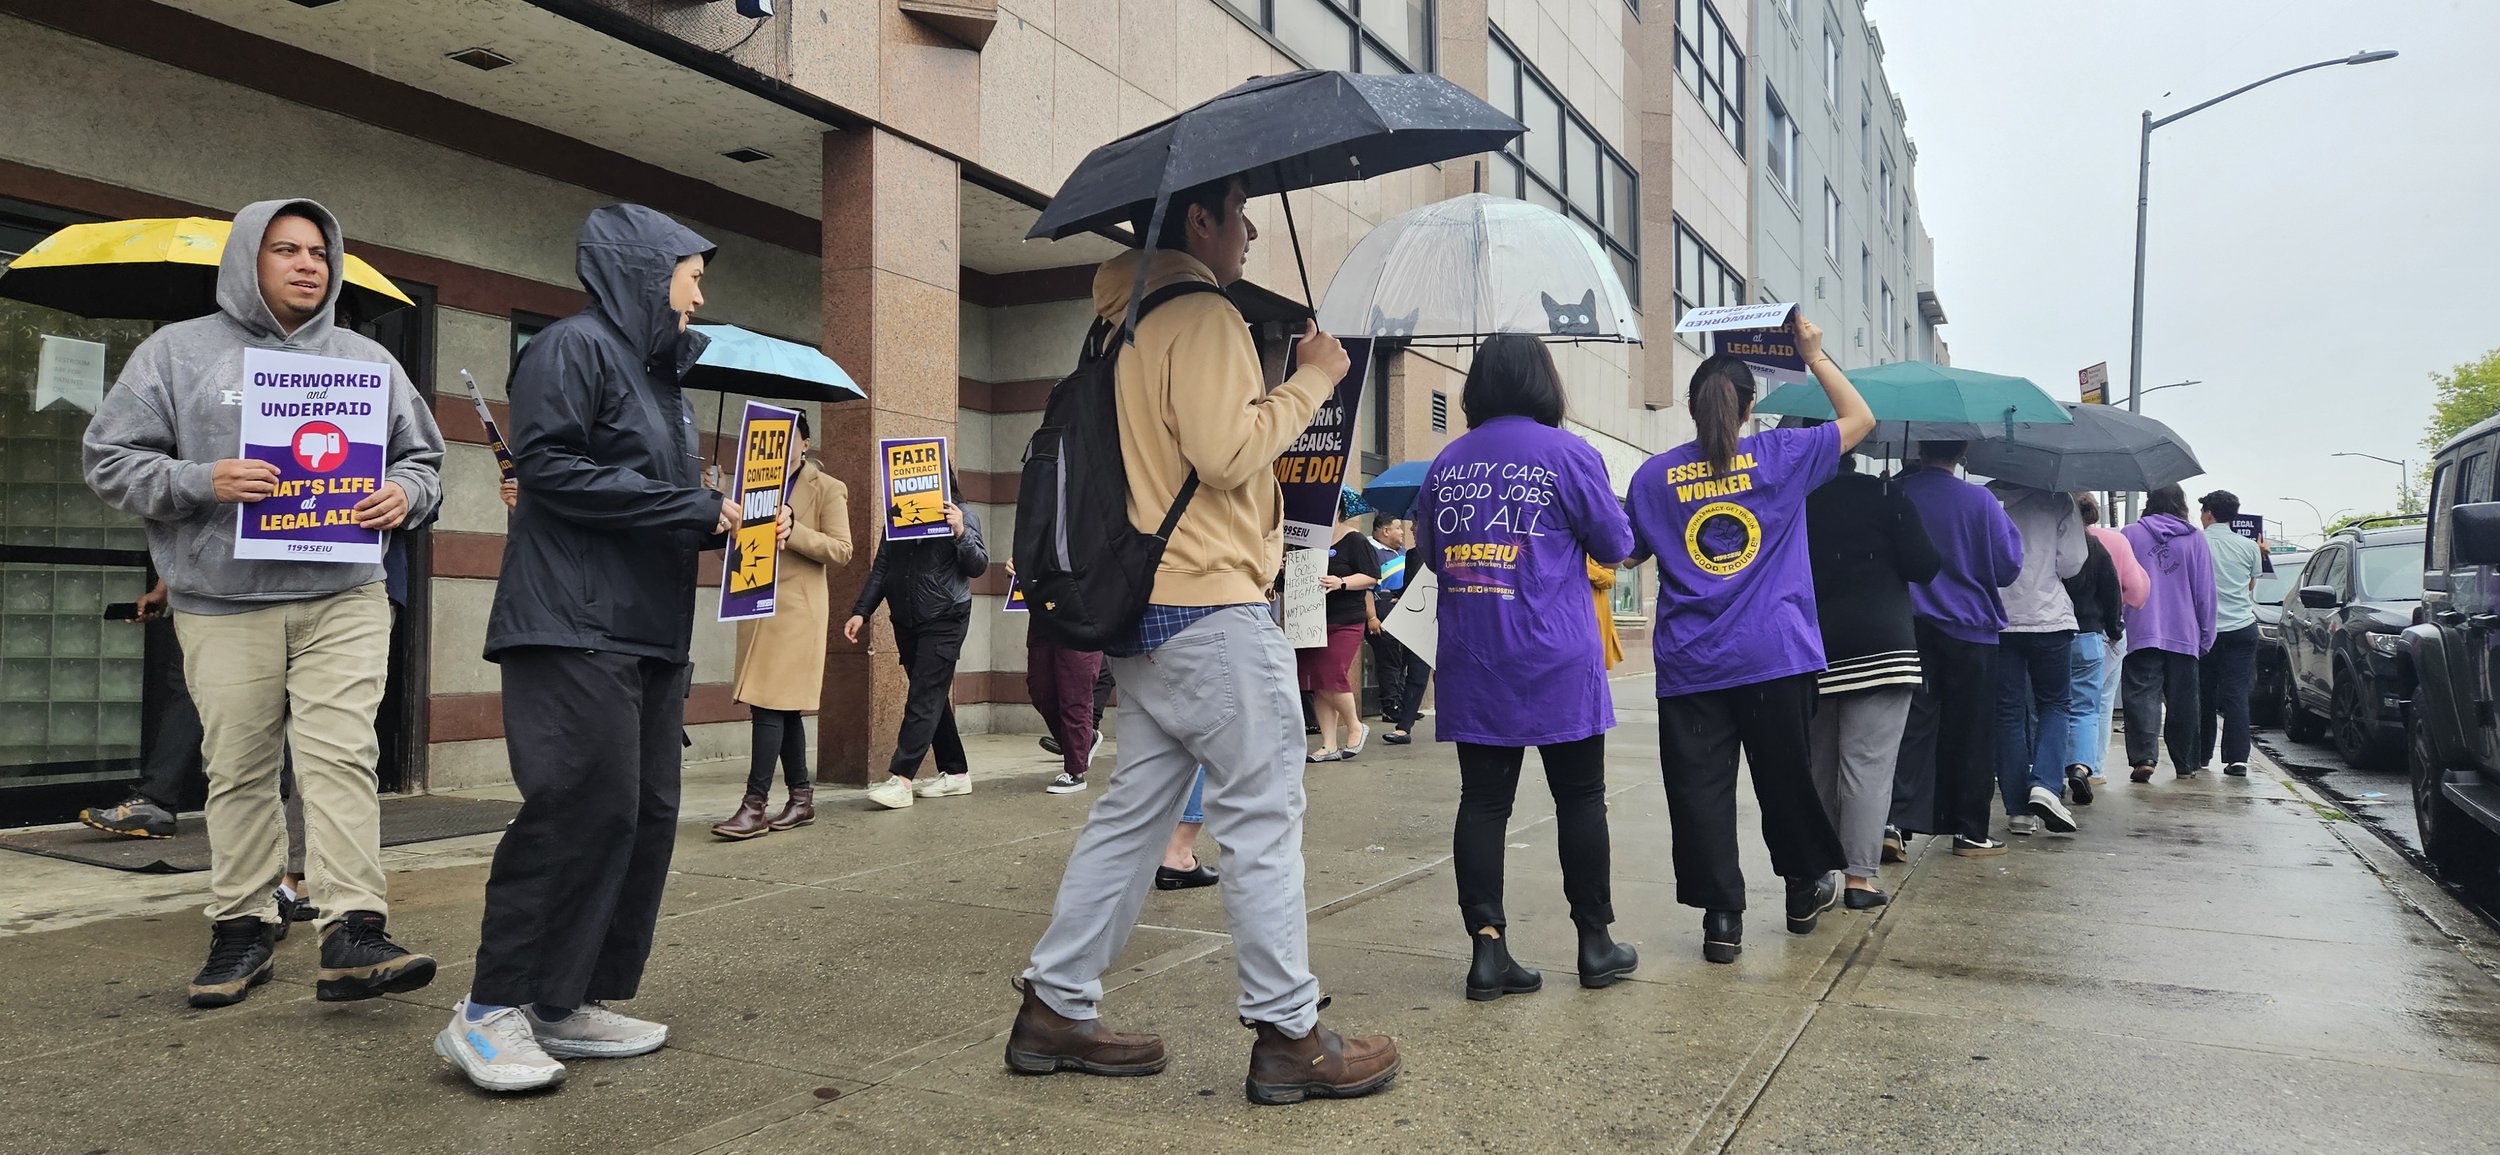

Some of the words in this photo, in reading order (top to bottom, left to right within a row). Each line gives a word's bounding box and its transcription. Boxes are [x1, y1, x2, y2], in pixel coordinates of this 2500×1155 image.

[1684, 310, 1782, 328] OVERWORKED
[1753, 332, 1763, 343] at
[1727, 342, 1767, 355] LEGAL
[1768, 343, 1794, 357] AID
[254, 372, 381, 388] OVERWORKED
[307, 387, 328, 400] and
[261, 402, 371, 417] UNDERPAID
[749, 429, 786, 461] FAIR
[1286, 432, 1342, 452] ECAUSE
[892, 447, 937, 467] FAIR
[746, 465, 782, 483] CONTRACT
[893, 464, 938, 476] CONTRACT
[1273, 456, 1306, 483] WE
[1305, 456, 1344, 484] DO!
[1502, 463, 1558, 487] CARE
[328, 477, 375, 494] LIFE
[894, 475, 939, 494] NOW!
[1676, 473, 1752, 503] WORKER
[300, 495, 317, 510] at
[1438, 482, 1492, 502] GOOD
[1498, 484, 1554, 506] JOBS
[742, 488, 780, 521] NOW!
[260, 511, 321, 531] LEGAL
[1435, 504, 1476, 534] OR
[1484, 505, 1545, 537] ALL
[2232, 520, 2255, 528] LEGAL
[287, 544, 333, 553] 1199SEIU
